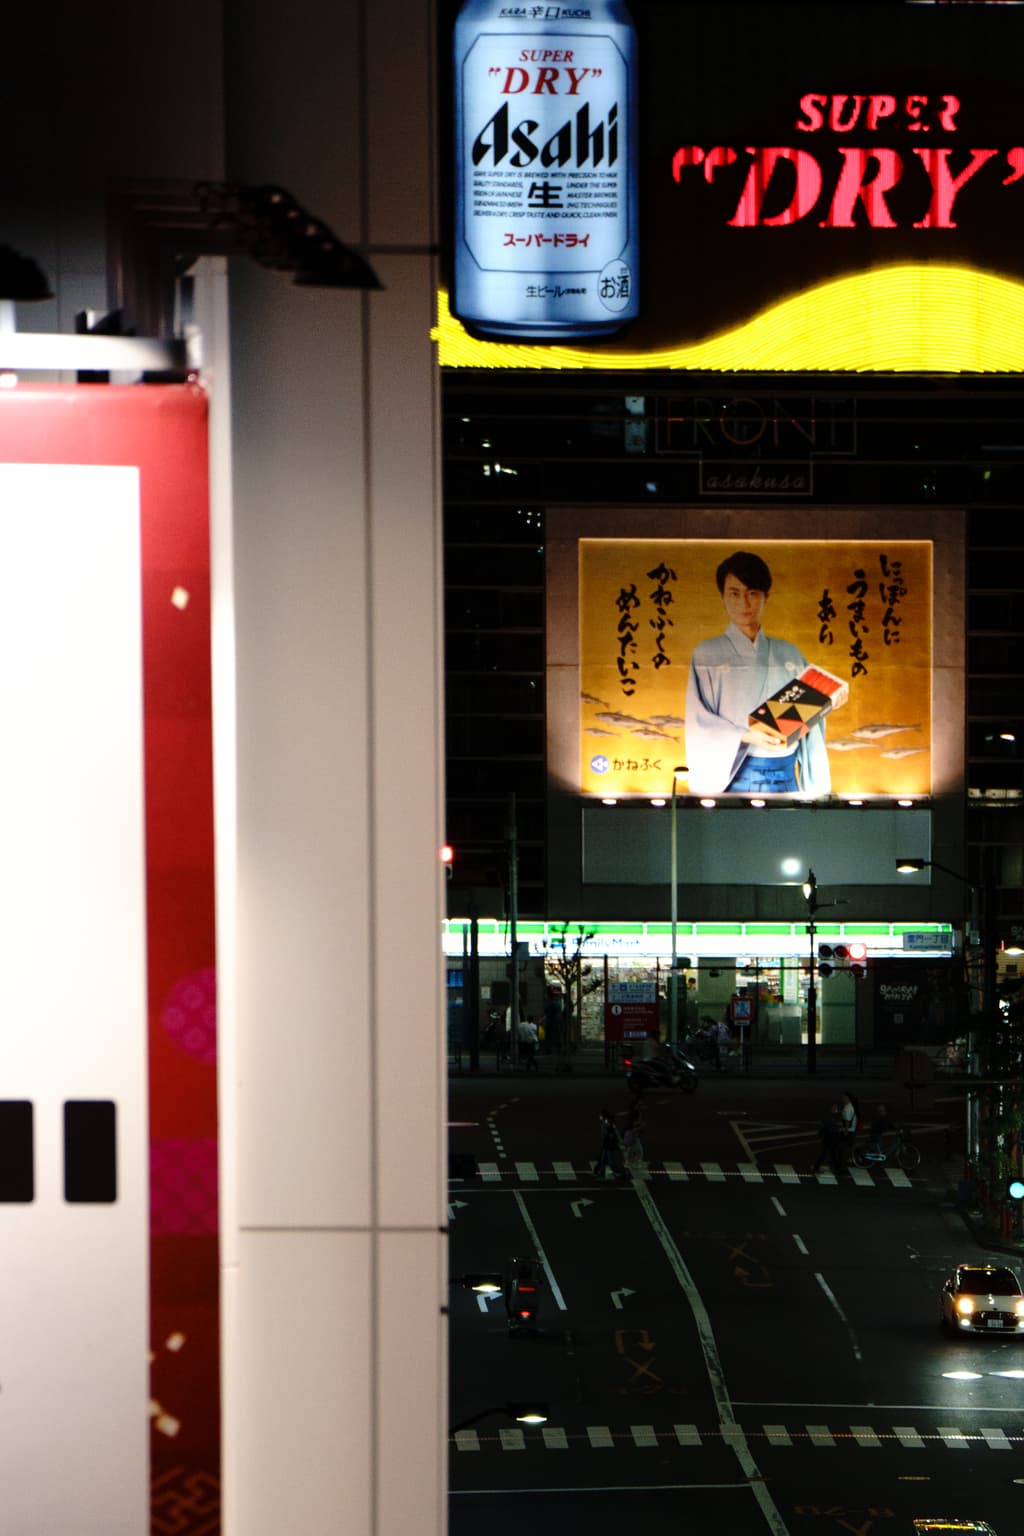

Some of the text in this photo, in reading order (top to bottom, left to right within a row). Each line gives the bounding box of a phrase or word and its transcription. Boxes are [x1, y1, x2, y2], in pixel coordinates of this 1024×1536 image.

[500, 8, 526, 16] KARA
[562, 8, 593, 17] KUCHI
[519, 49, 574, 62] SUPER
[795, 92, 961, 133] SUPER
[472, 101, 618, 168] Asahi
[528, 181, 563, 209] 生
[504, 233, 590, 247] スーパードライ
[647, 562, 678, 670] かねふくの
[616, 584, 641, 697] めんたいこ
[612, 757, 662, 771] かねふく
